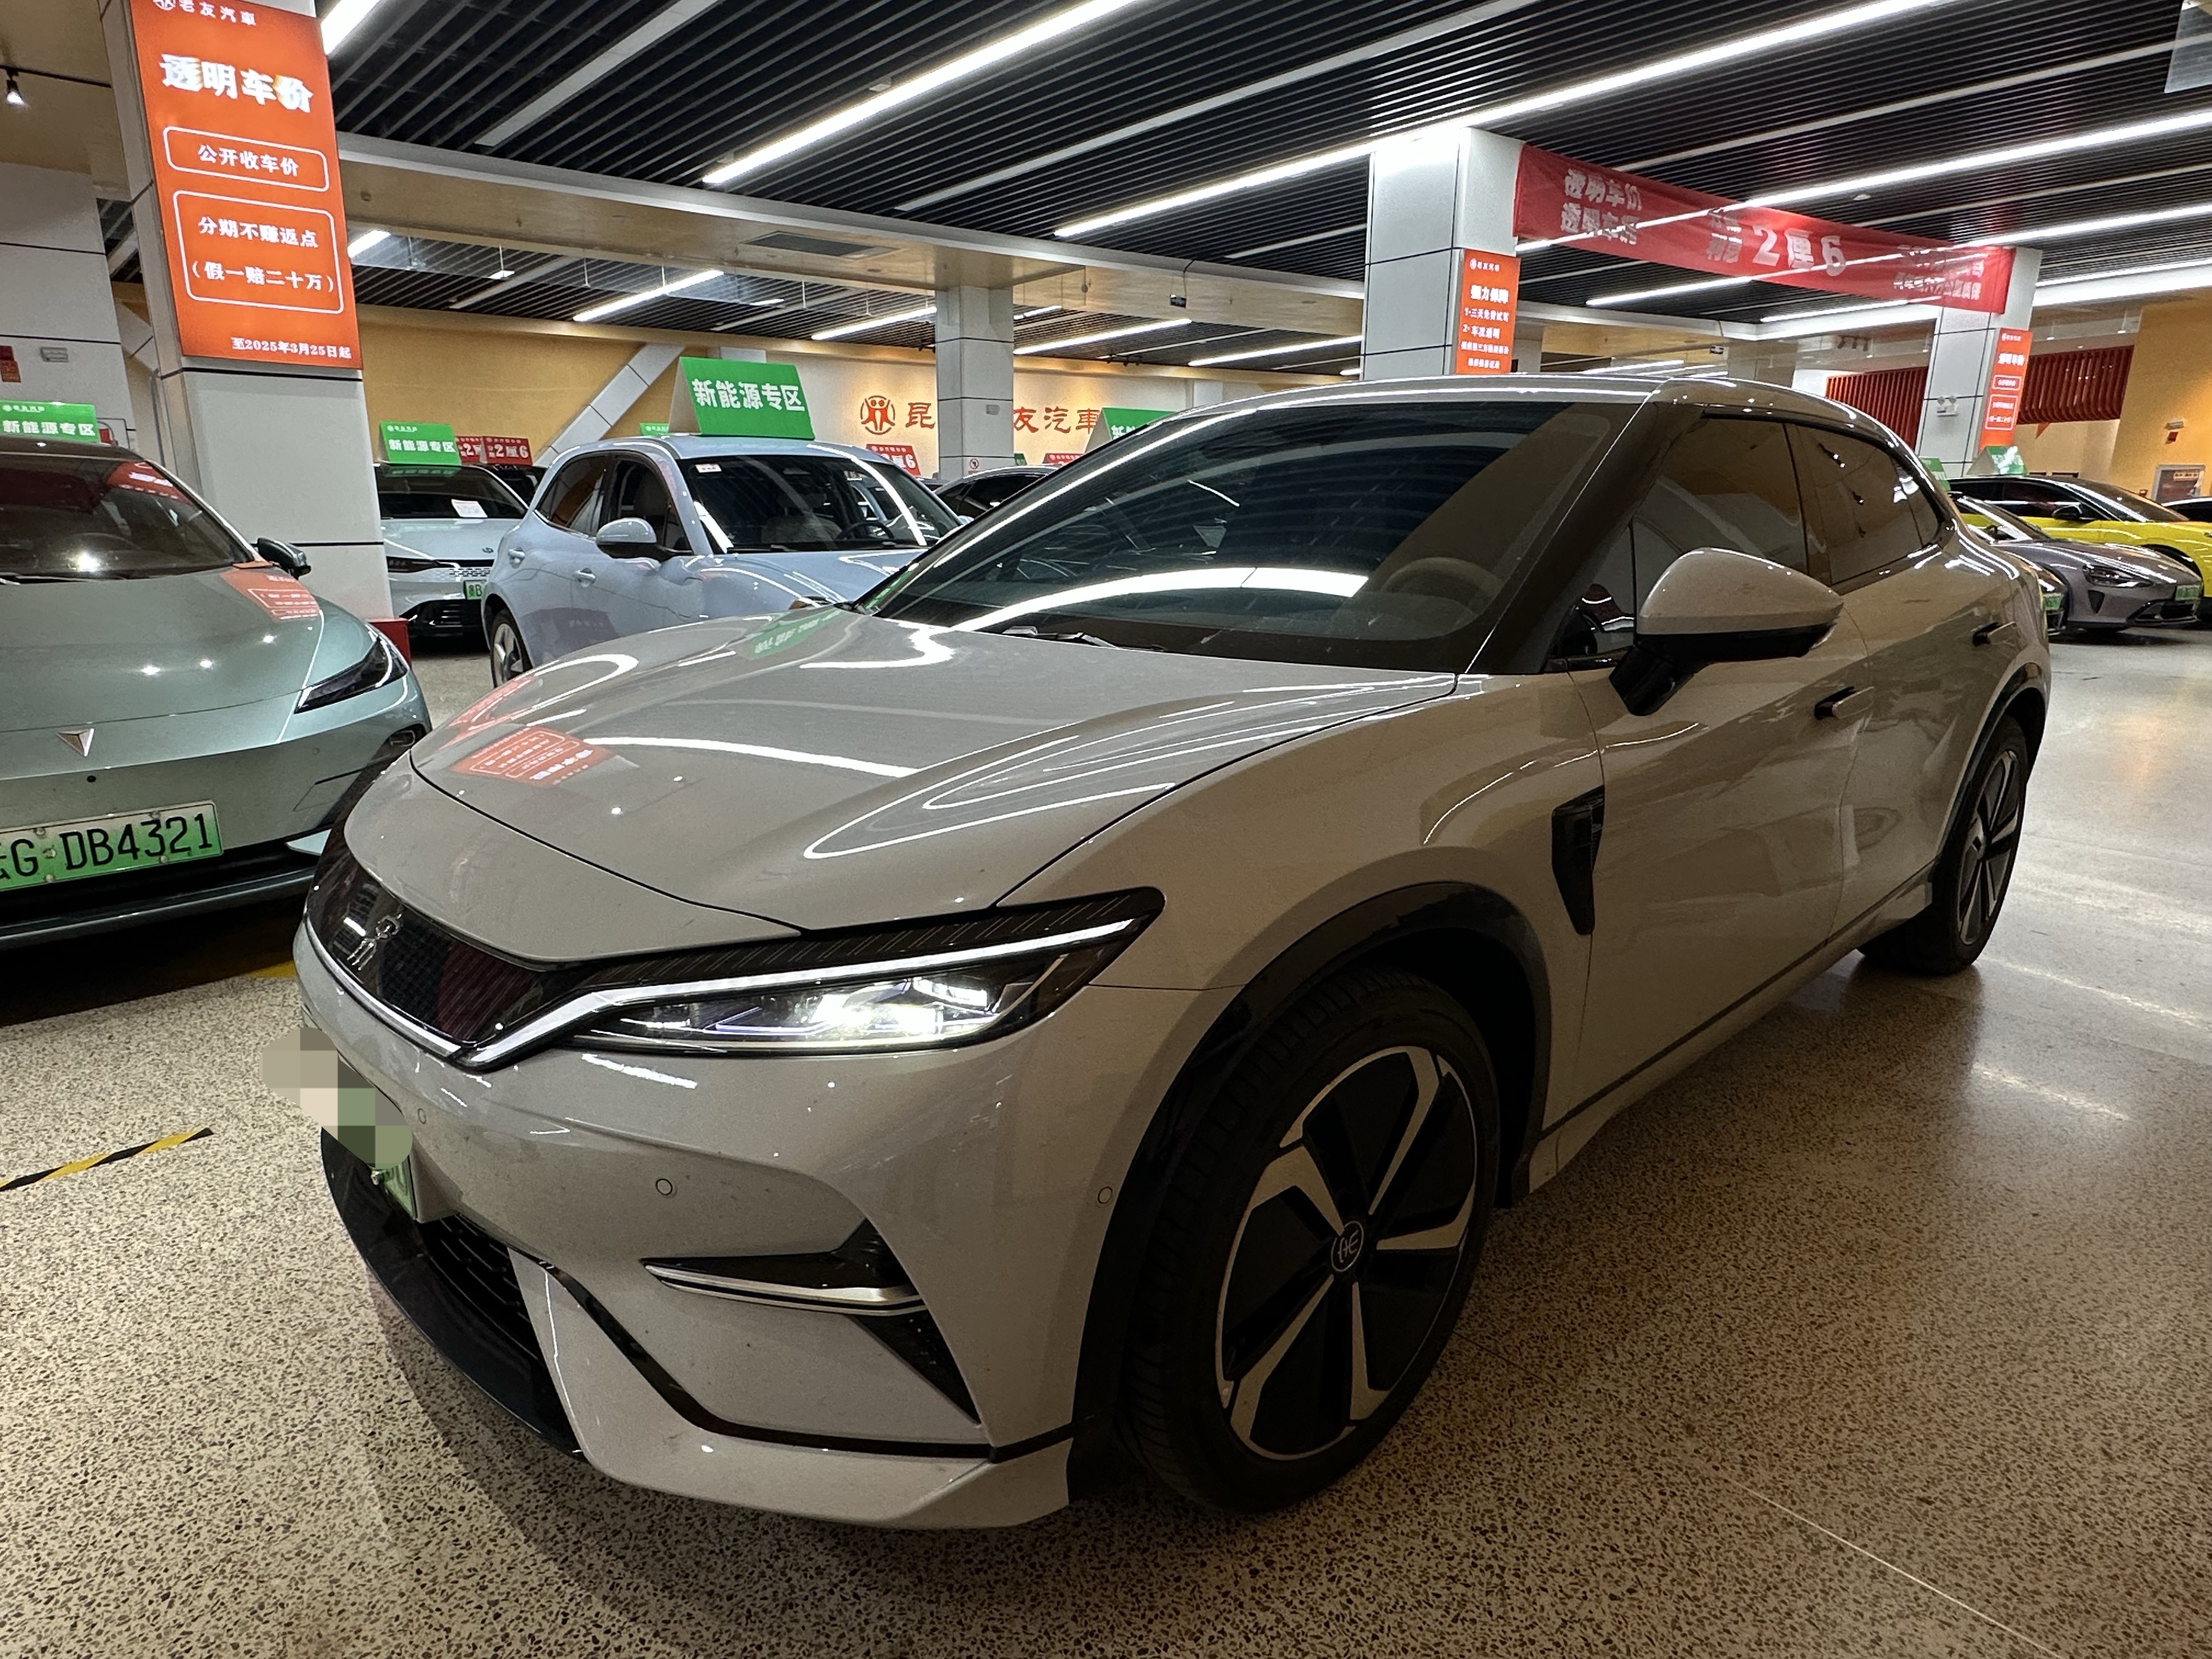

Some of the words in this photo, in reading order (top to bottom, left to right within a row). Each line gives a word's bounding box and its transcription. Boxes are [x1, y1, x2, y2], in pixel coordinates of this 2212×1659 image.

[159, 53, 314, 113] 透明车价
[198, 144, 298, 176] 公开收车价
[198, 216, 318, 248] 分期不赚返点
[231, 337, 352, 359] 至2025年3月25日起
[691, 379, 805, 411] 新能源专区
[2, 420, 95, 436] 新能源专区
